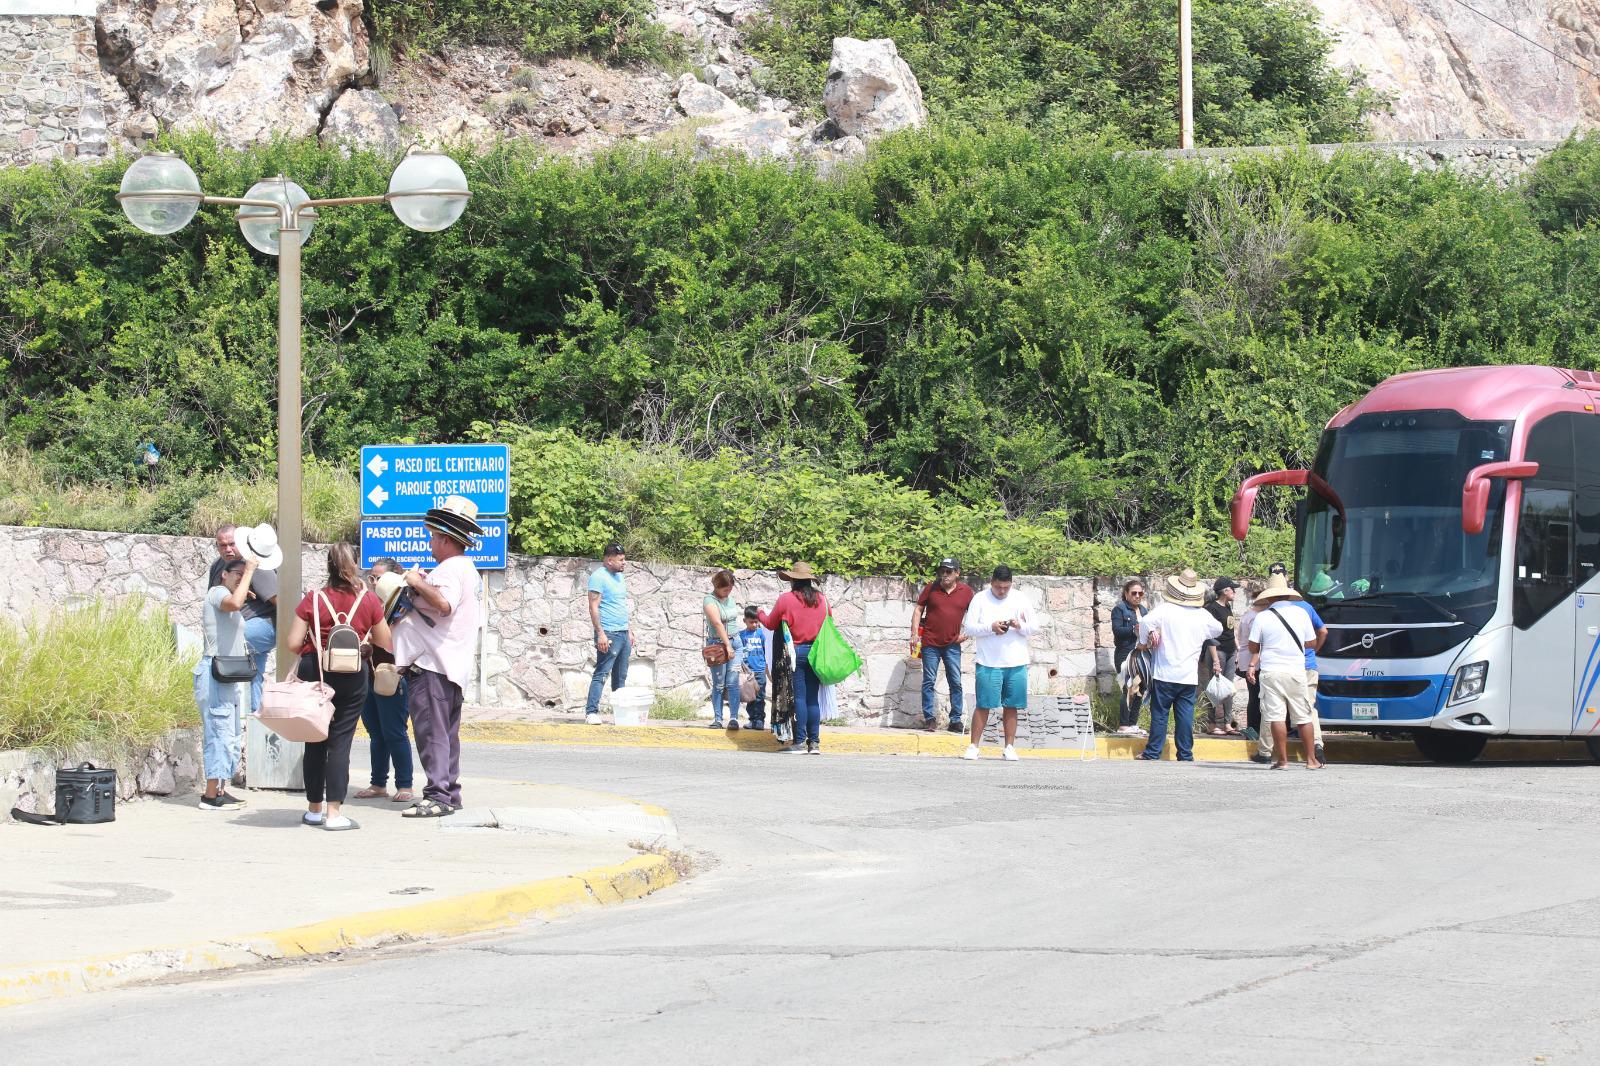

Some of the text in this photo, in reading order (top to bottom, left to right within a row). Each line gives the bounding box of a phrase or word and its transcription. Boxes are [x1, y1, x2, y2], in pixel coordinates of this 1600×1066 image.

[395, 457, 505, 472] PASEO DEL CENTENARIO
[396, 479, 504, 495] PARQUE OBSERVATORIO
[366, 527, 402, 538] PASEO
[405, 527, 426, 538] DEL
[1361, 668, 1385, 677] Tours
